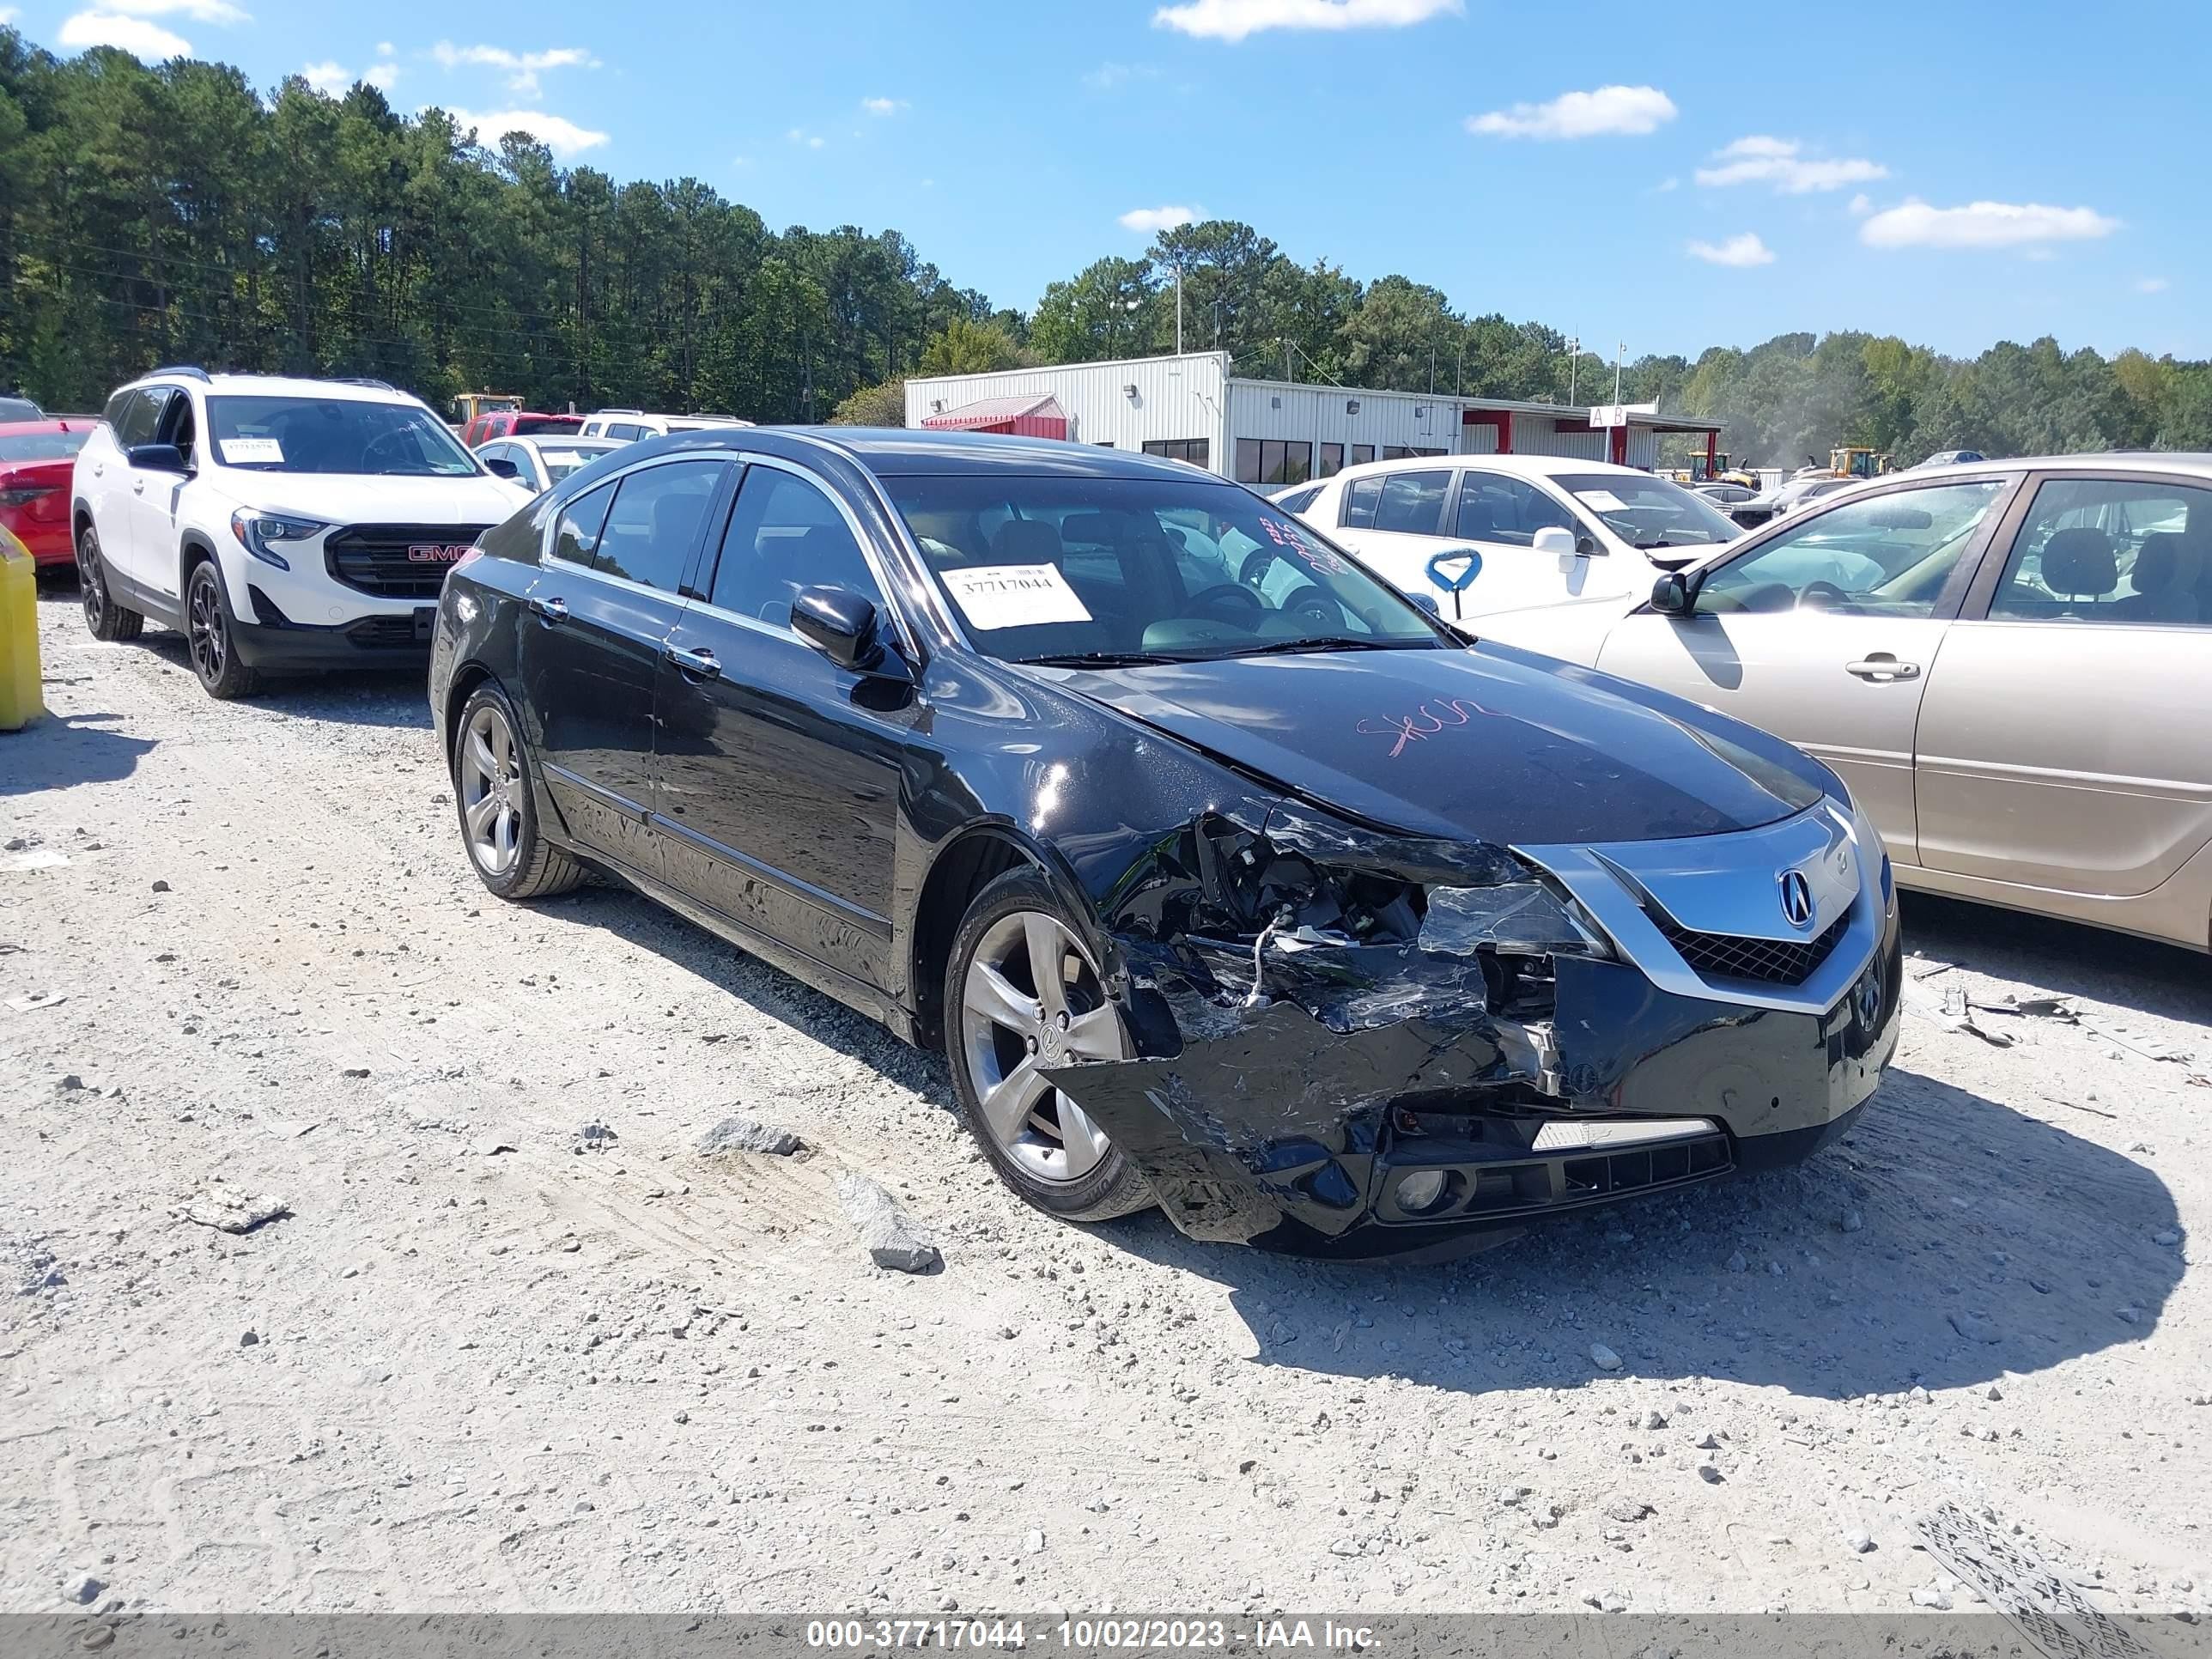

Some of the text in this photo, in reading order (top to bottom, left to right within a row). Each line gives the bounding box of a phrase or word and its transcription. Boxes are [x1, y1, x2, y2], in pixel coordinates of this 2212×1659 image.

[1592, 406, 1623, 426] A B
[961, 577, 1054, 595] 37717044
